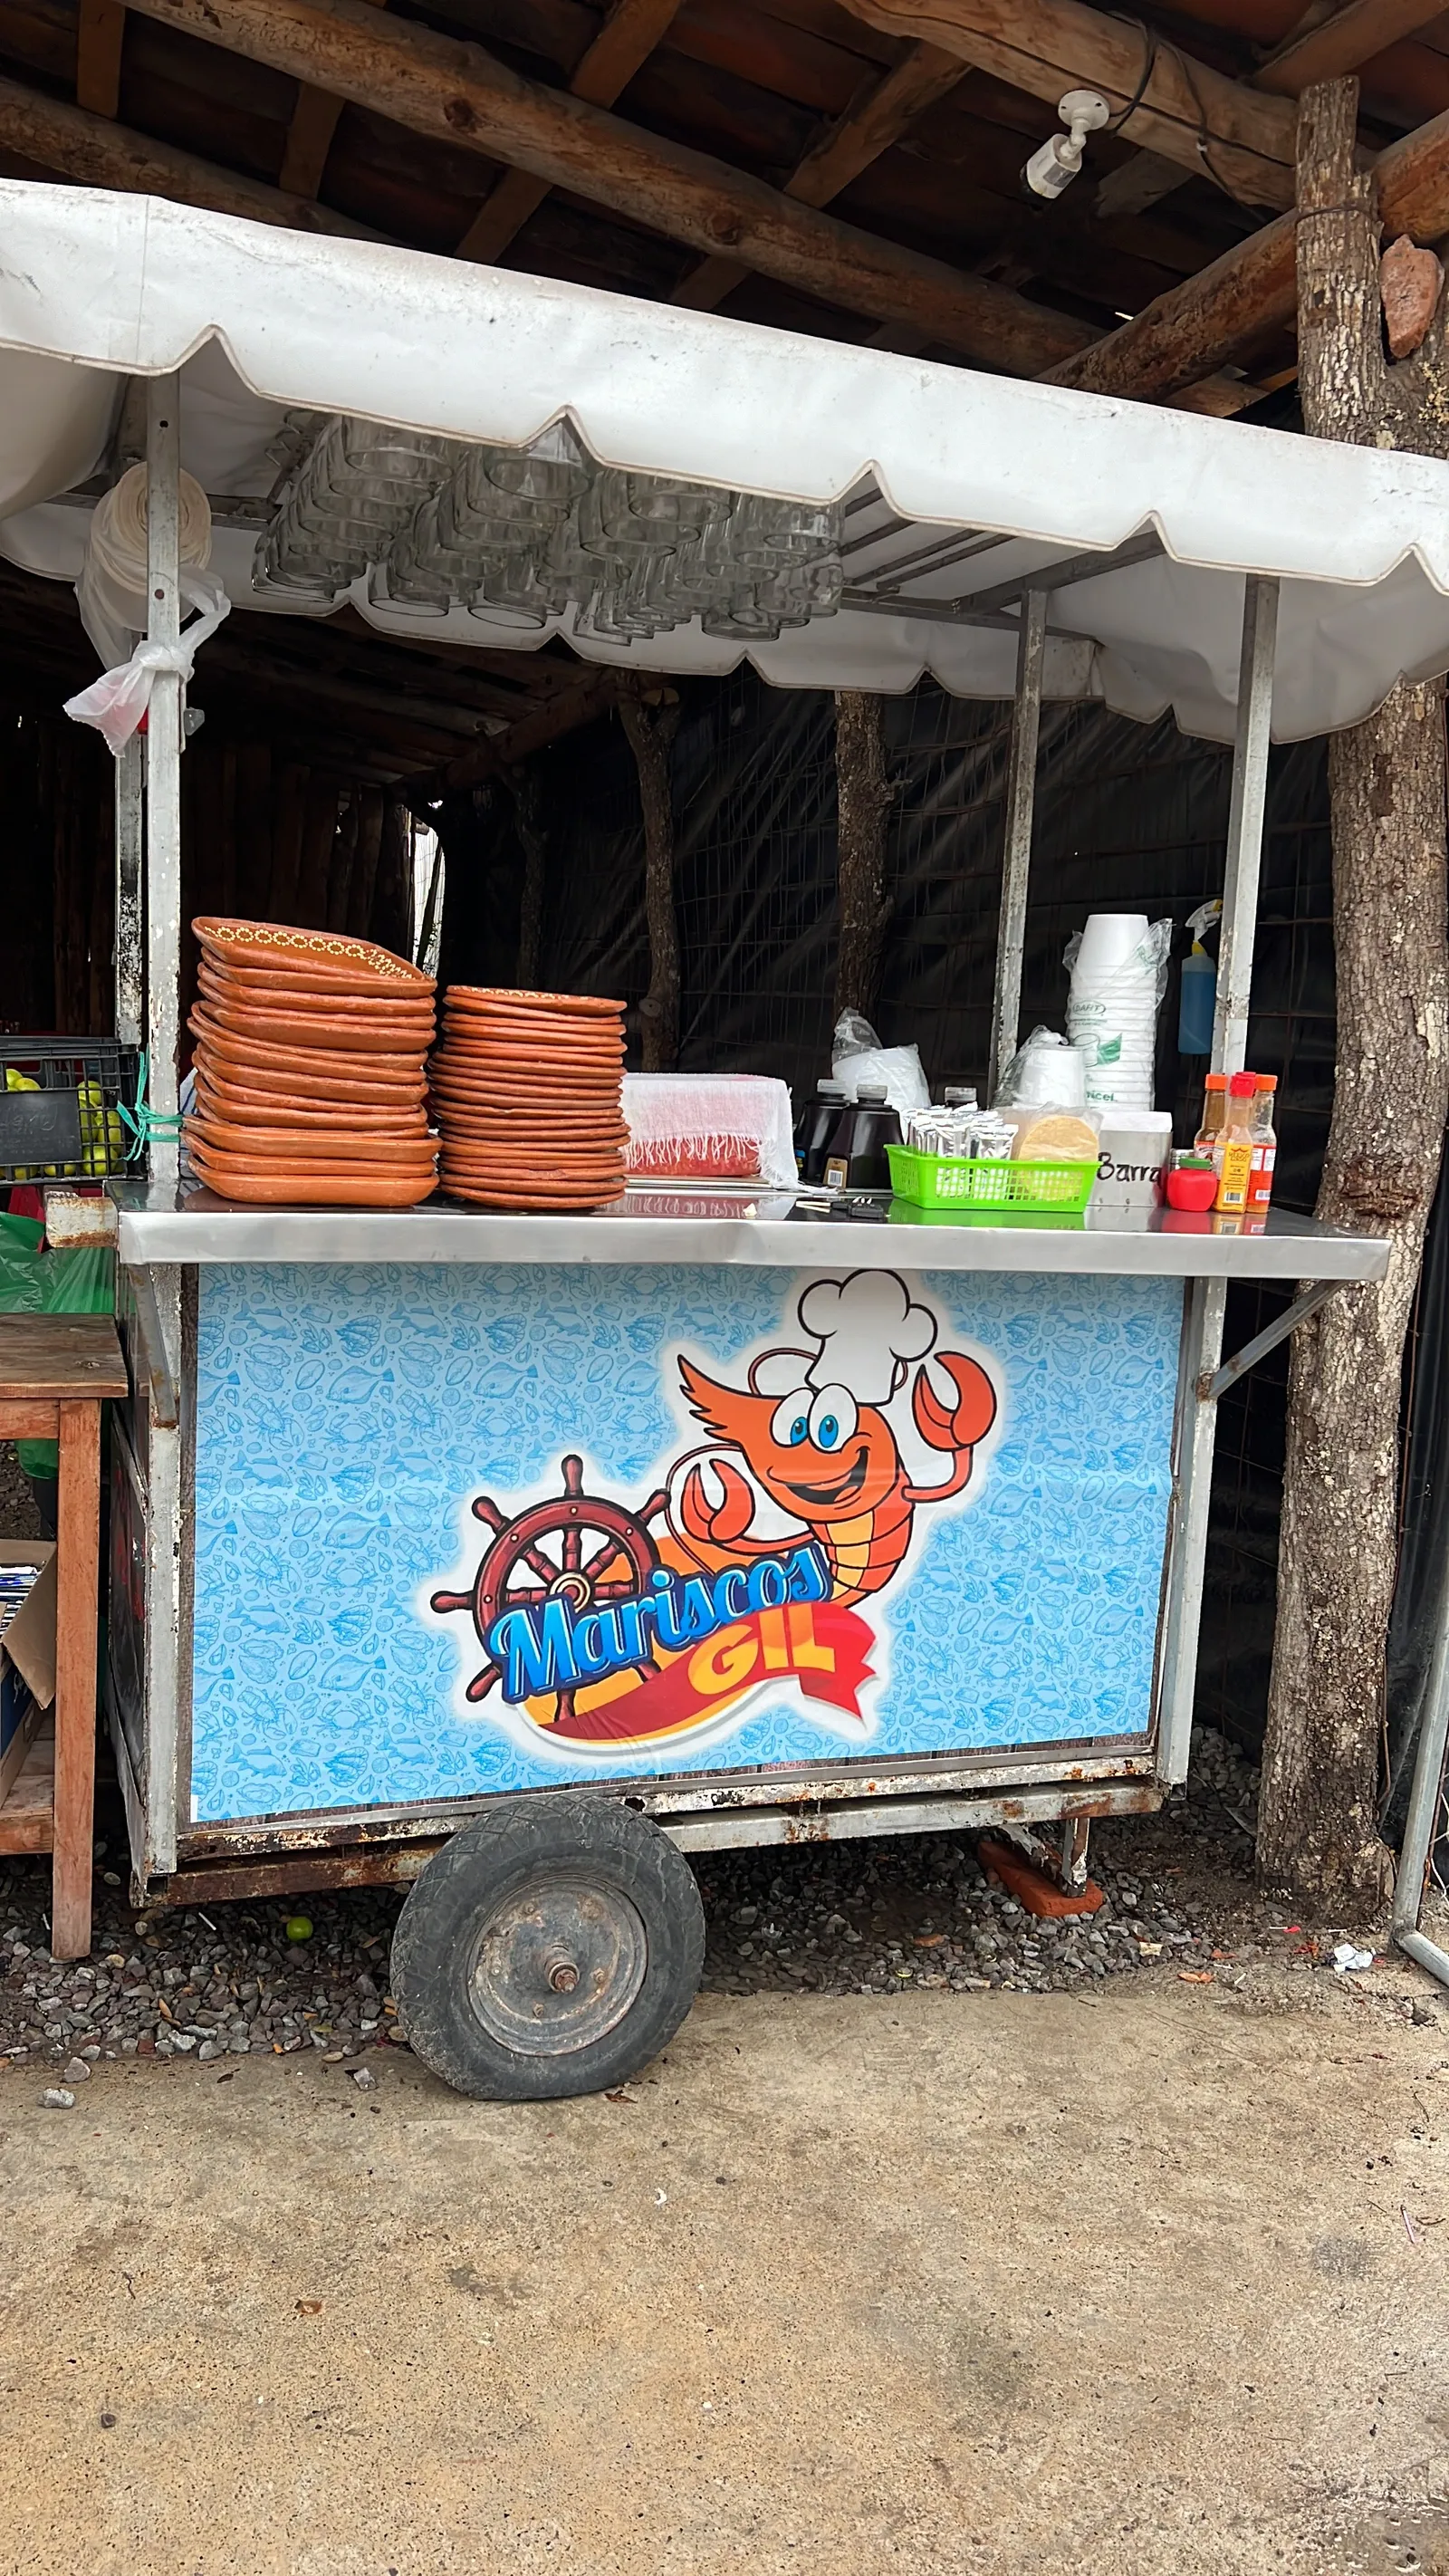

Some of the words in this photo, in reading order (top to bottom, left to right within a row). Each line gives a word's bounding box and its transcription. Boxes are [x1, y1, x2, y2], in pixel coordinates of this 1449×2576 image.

[1097, 1151, 1163, 1188] Barra
[490, 1544, 827, 1698] Mariscos
[687, 1604, 836, 1696] GIL
